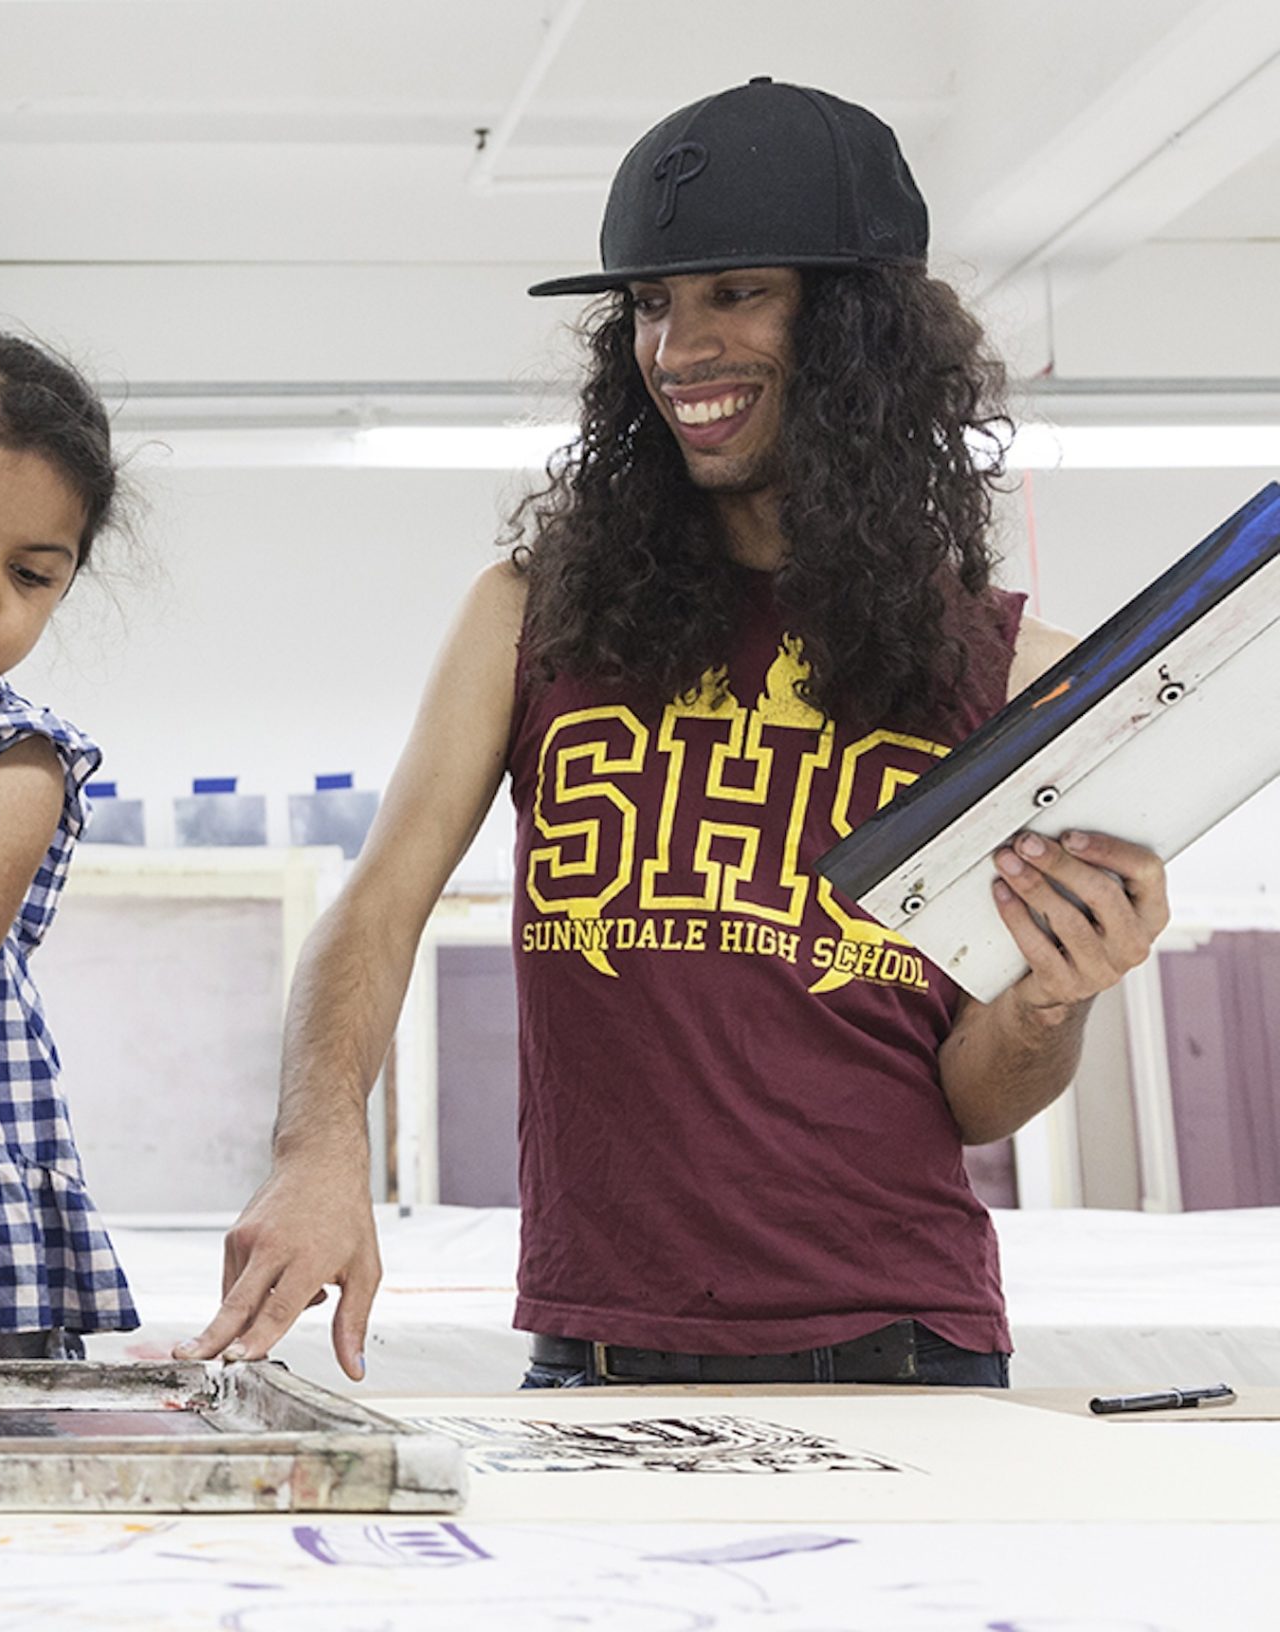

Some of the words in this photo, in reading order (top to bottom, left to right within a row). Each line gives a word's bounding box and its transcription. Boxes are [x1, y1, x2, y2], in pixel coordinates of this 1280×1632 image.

[653, 141, 710, 229] P
[522, 918, 708, 952] SUNNYDALE
[719, 920, 801, 964] HIGH
[811, 937, 930, 989] SCHOOL
